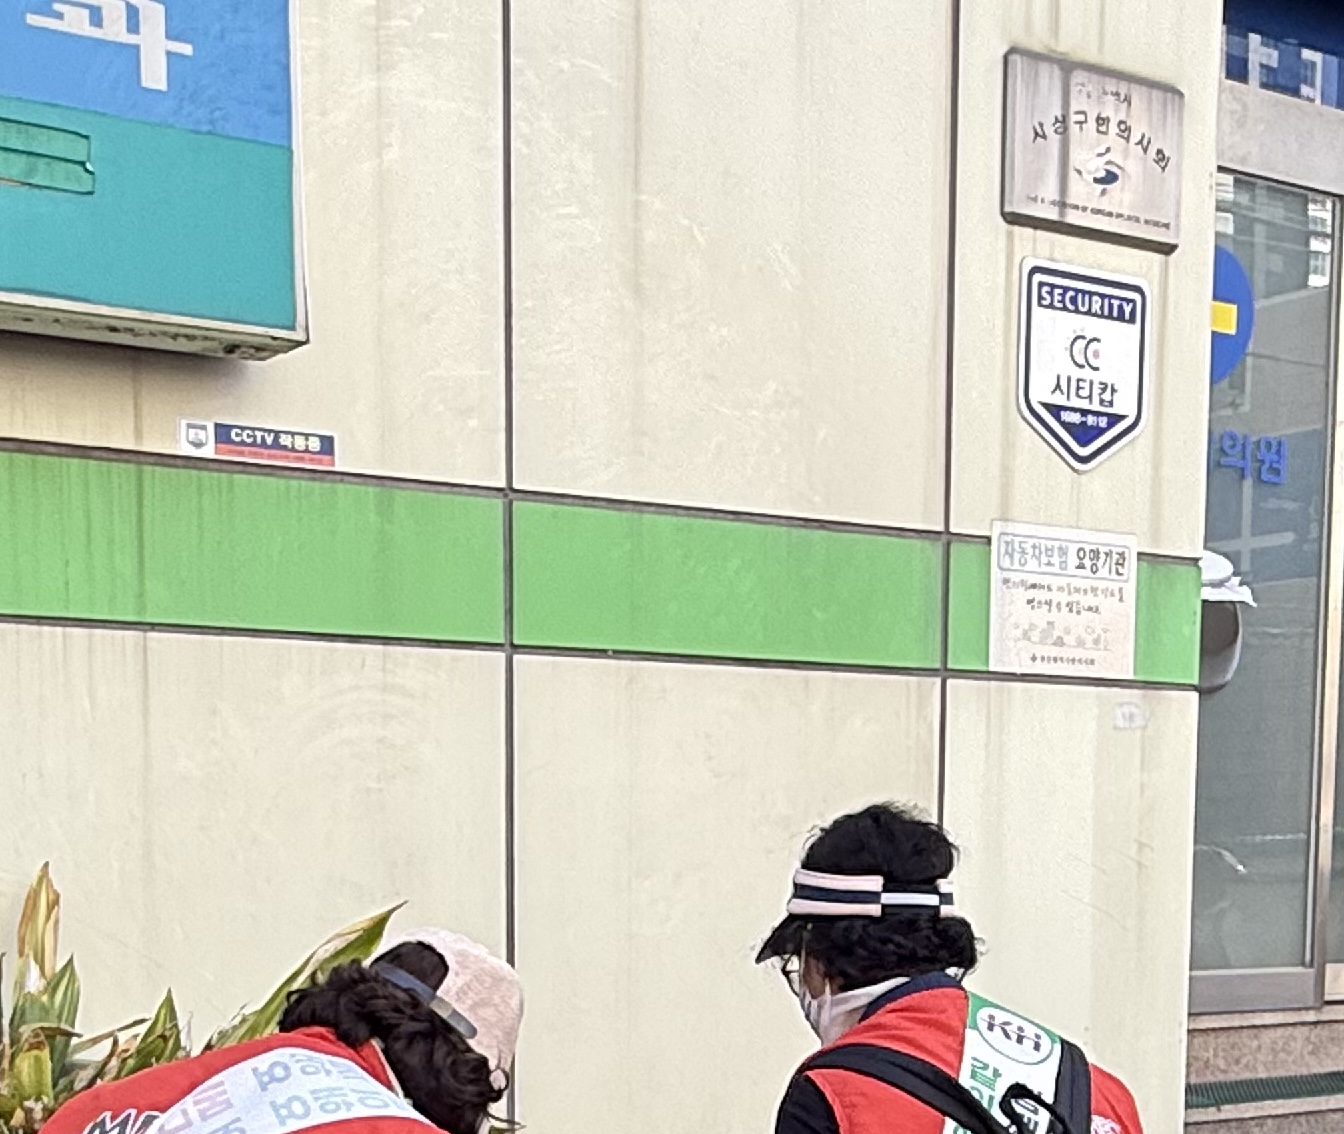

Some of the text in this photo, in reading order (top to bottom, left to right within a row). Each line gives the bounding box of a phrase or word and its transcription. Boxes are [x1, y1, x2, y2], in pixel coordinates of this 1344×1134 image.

[1040, 284, 1134, 321] SECURITY
[1051, 374, 1119, 408] 시티캅
[230, 427, 275, 446] CCTV
